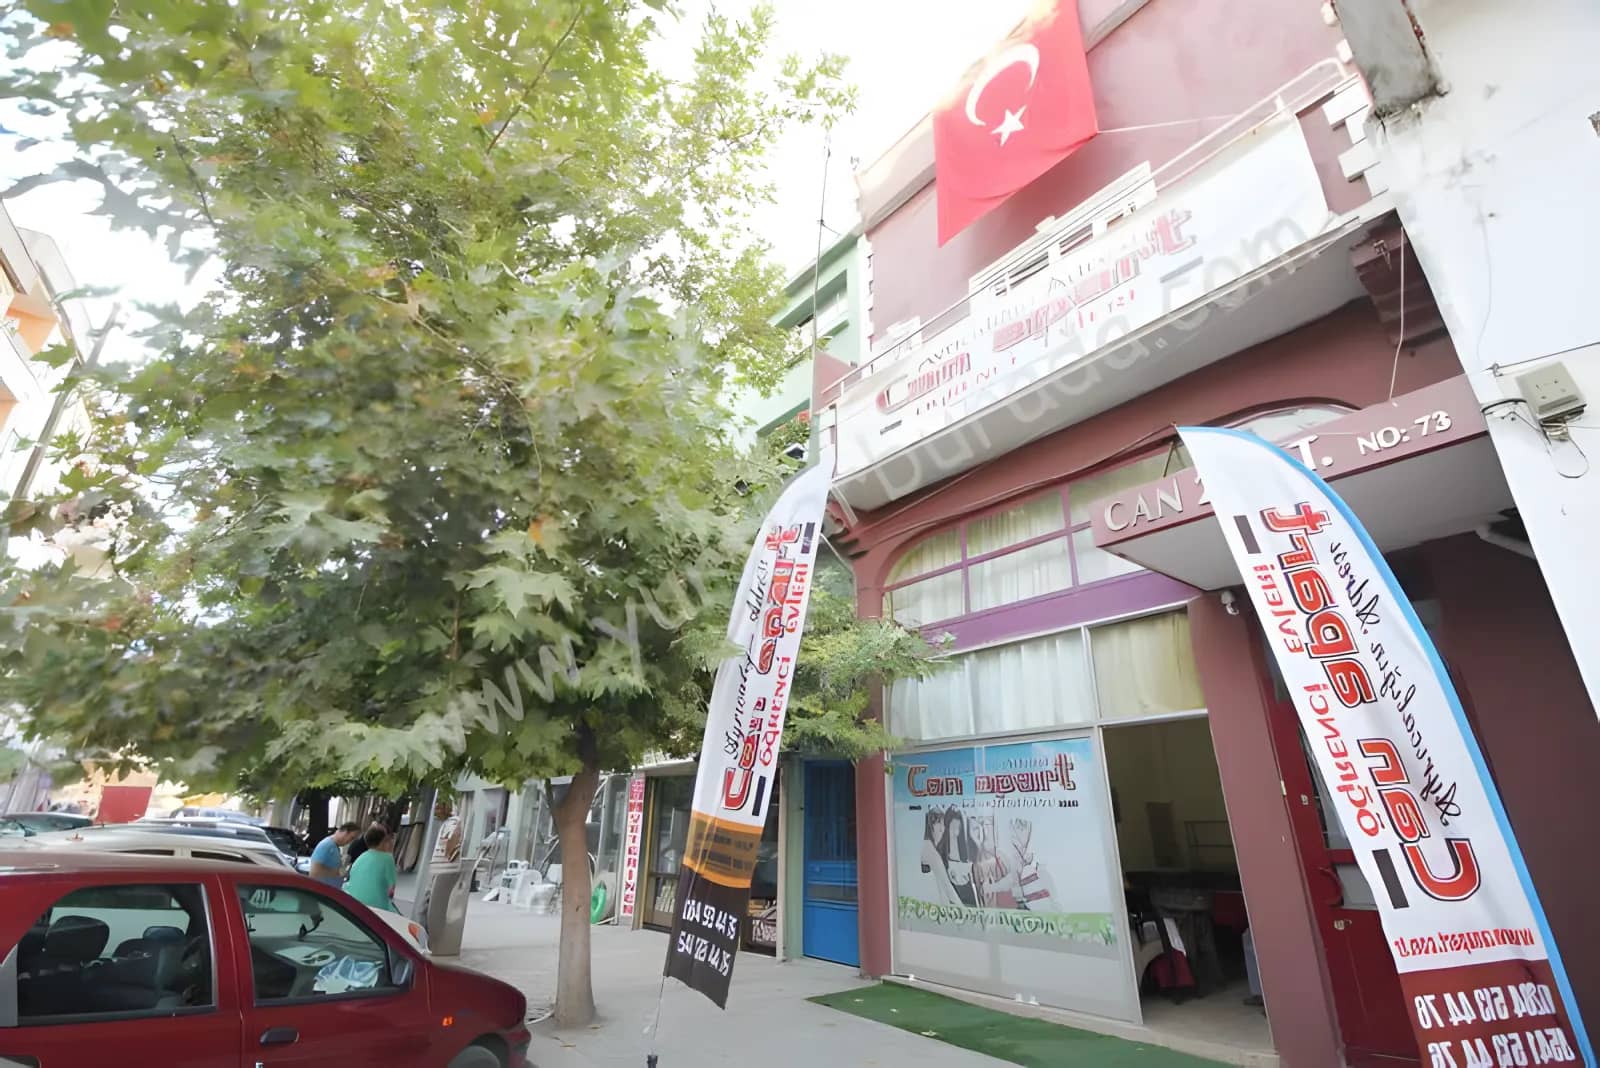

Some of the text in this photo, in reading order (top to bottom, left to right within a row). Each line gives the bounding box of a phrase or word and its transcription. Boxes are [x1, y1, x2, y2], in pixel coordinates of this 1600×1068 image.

[1103, 477, 1183, 532] CAN
[1357, 423, 1410, 455] NO:
[1414, 410, 1452, 437] 73
